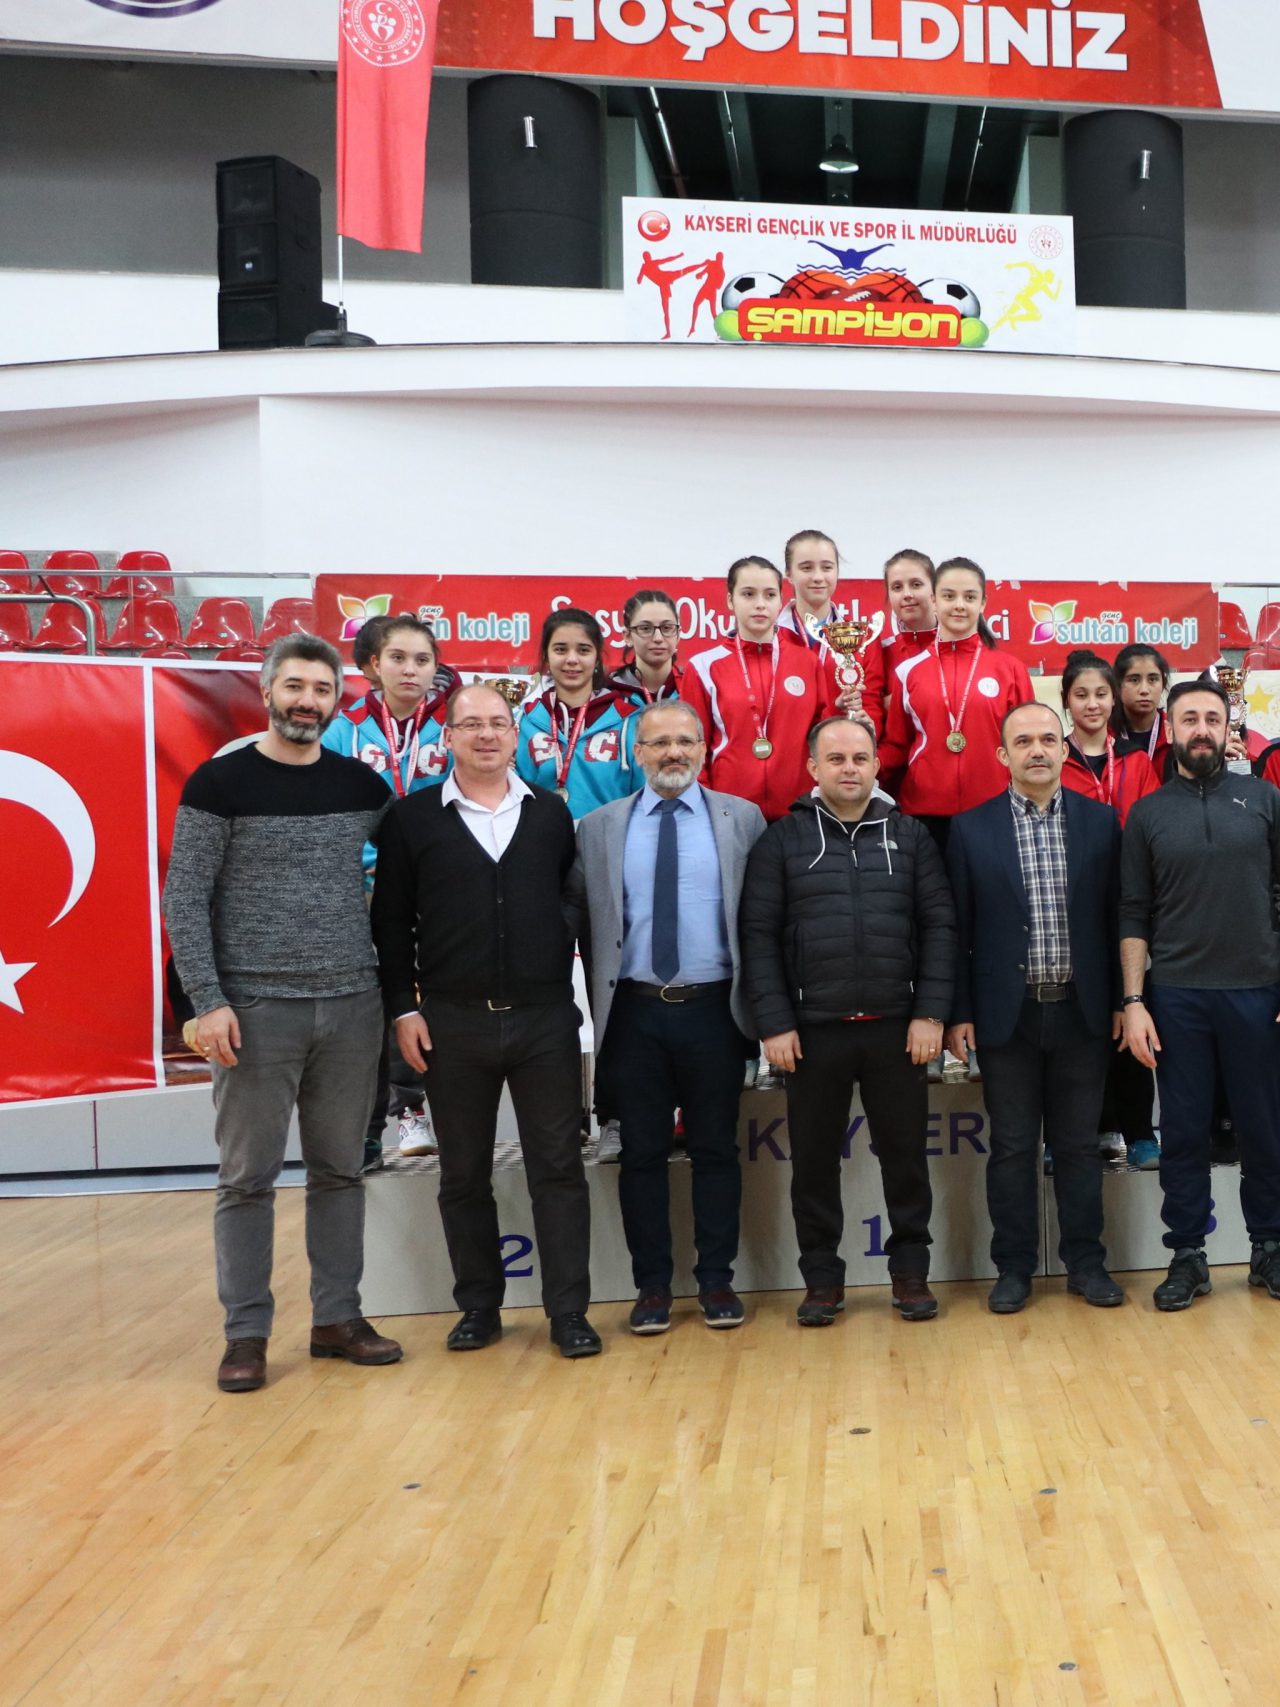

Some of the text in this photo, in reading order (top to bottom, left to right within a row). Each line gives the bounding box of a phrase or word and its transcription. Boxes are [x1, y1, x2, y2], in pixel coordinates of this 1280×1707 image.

[532, 0, 1129, 71] HOŞGELDİNİZ
[684, 212, 1017, 244] KAYSERİ GENÇLİK VE SPOR İL MÜDÜRLÜĞÜ
[458, 612, 530, 647] koleji
[676, 597, 737, 640] Oku
[1056, 617, 1198, 649] sultan koleji
[498, 1234, 534, 1278] 2
[862, 1214, 891, 1257] 1
